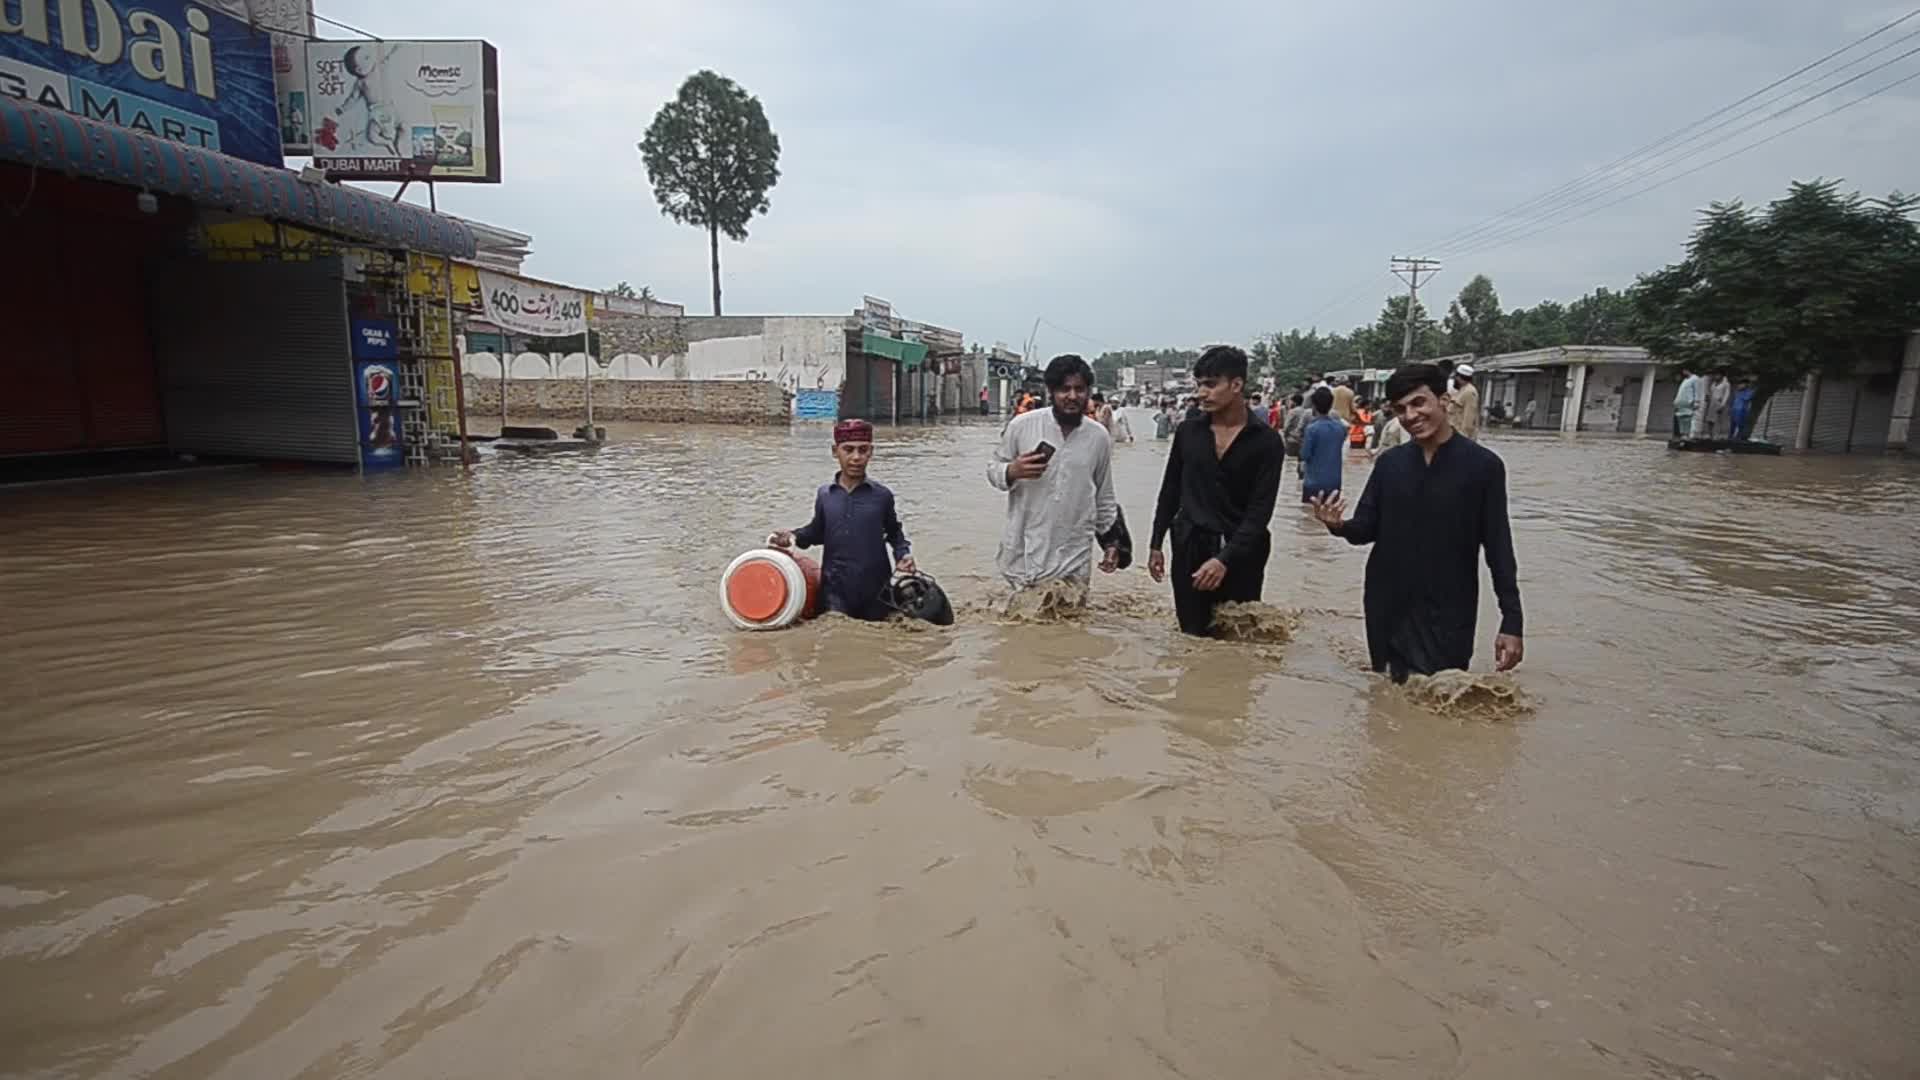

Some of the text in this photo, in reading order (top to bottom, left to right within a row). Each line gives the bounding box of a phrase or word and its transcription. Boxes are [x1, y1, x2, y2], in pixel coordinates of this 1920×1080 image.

[316, 60, 345, 74] SOFT
[318, 82, 345, 96] SOFT
[81, 88, 213, 148] MART
[320, 159, 401, 171] DUBAI MART
[491, 289, 519, 315] 400
[561, 301, 581, 320] 400
